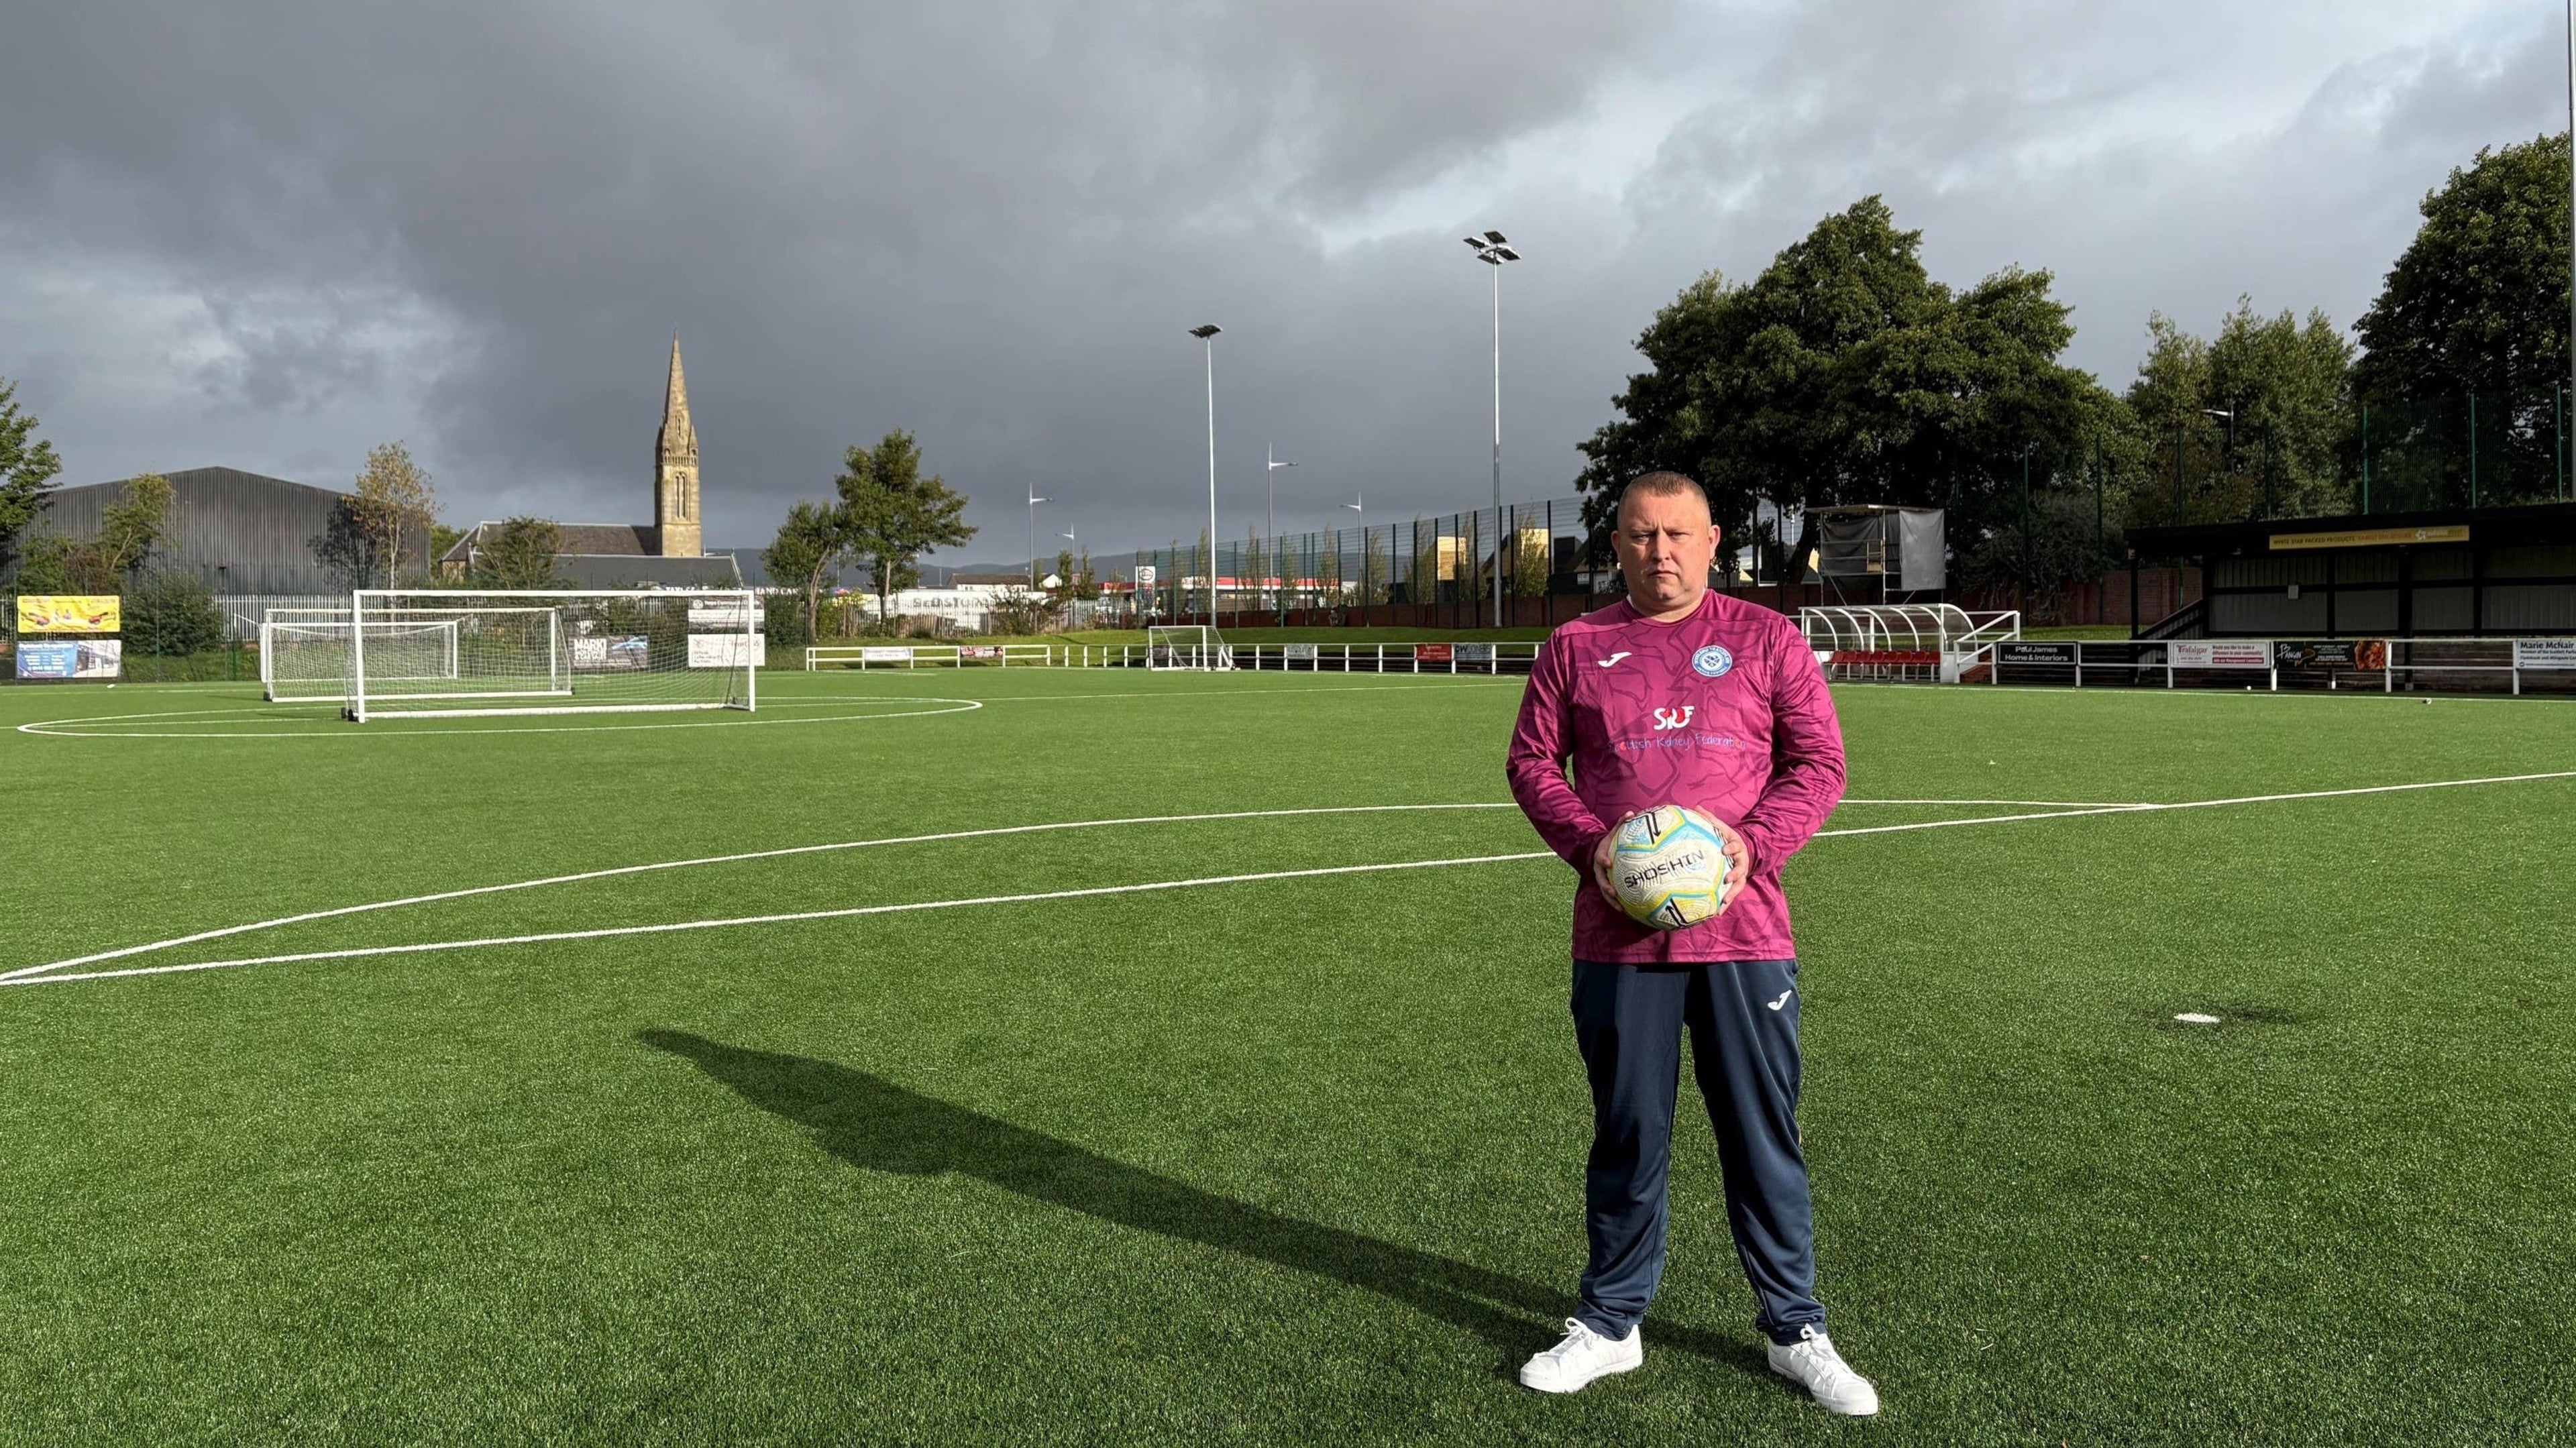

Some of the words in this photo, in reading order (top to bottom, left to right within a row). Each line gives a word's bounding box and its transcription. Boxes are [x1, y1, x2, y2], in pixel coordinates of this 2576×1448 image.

[2176, 645, 2208, 655] Trafalgar
[1656, 737, 1690, 751] Kidney
[1624, 850, 1705, 888] SHOSHIN
